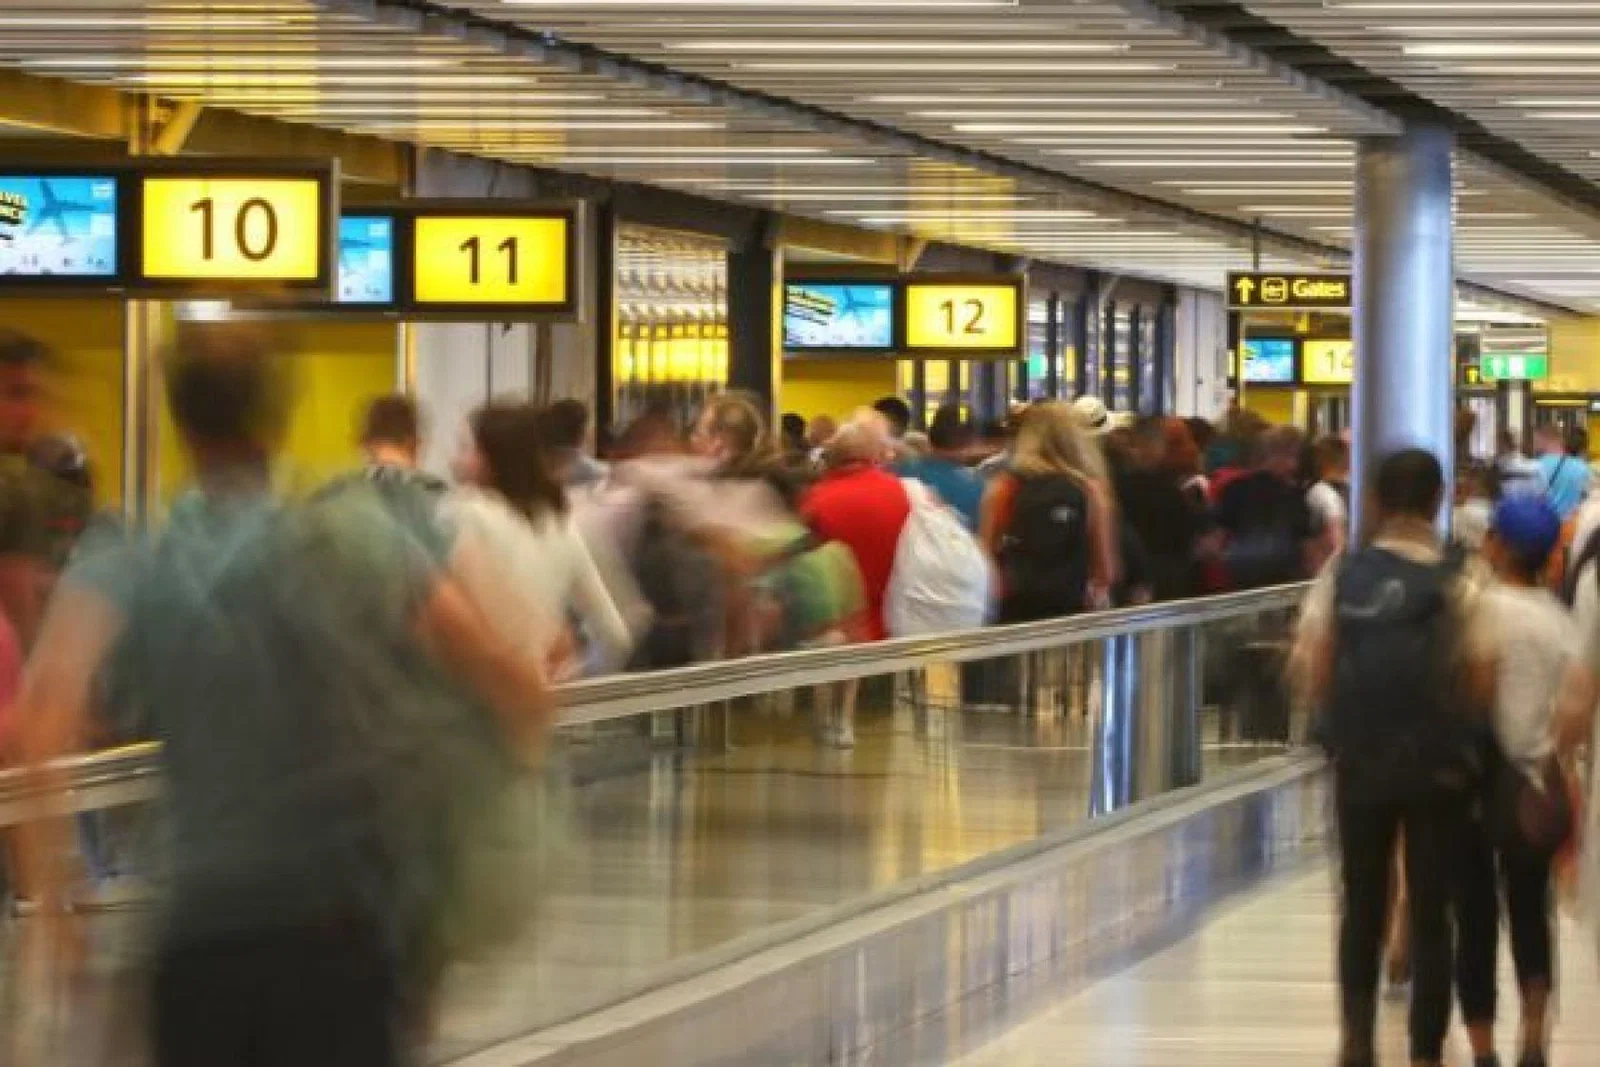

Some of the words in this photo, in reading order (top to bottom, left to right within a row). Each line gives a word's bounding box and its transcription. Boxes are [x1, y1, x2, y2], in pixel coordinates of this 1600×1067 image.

[189, 196, 278, 262] 10
[458, 236, 518, 286] 11
[939, 298, 987, 335] 12
